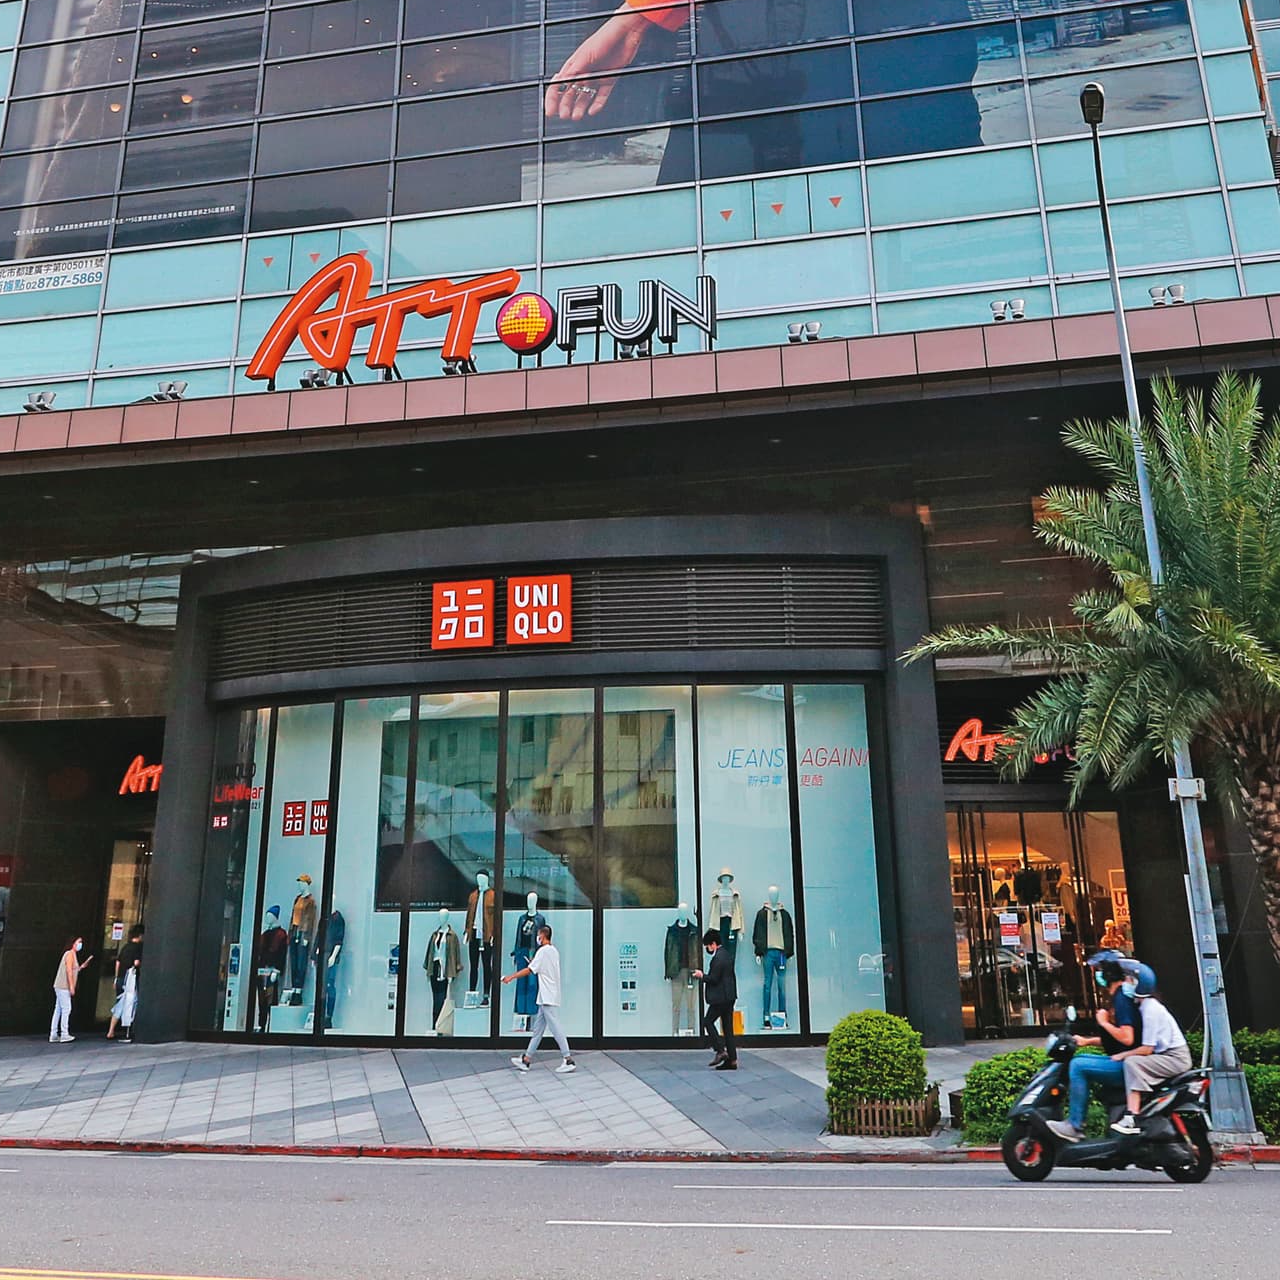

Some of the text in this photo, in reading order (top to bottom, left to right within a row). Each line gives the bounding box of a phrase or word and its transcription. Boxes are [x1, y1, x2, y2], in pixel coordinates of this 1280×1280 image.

[556, 274, 717, 351] FUN
[440, 588, 484, 613] ユニ
[514, 583, 559, 608] UNI
[438, 615, 484, 641] クロ
[514, 610, 563, 639] QLO
[214, 783, 264, 803] LifeWear
[314, 804, 328, 817] UN
